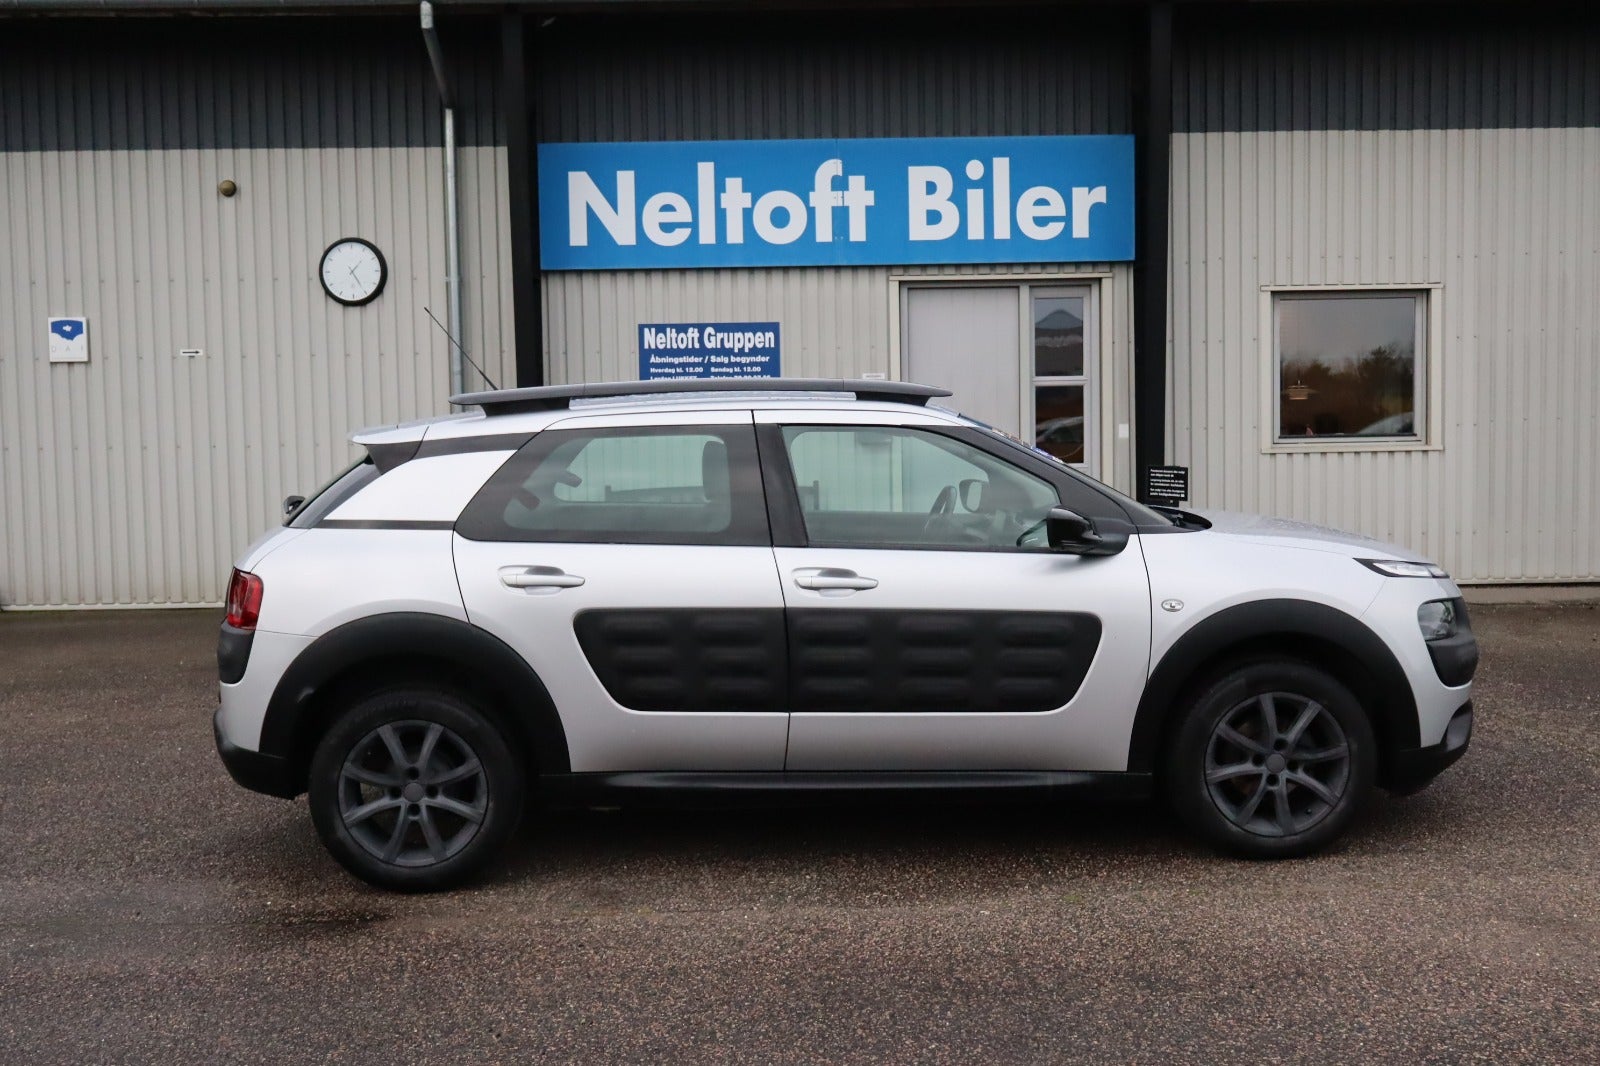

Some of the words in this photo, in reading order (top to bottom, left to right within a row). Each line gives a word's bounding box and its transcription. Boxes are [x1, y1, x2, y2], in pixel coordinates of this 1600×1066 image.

[568, 158, 874, 246] Neltoft
[908, 157, 1107, 241] Biler
[644, 327, 700, 349] Neltoft
[704, 326, 775, 352] Gruppen
[650, 354, 703, 364] Åbningstider
[710, 355, 729, 364] Salg
[730, 355, 770, 364] begynder
